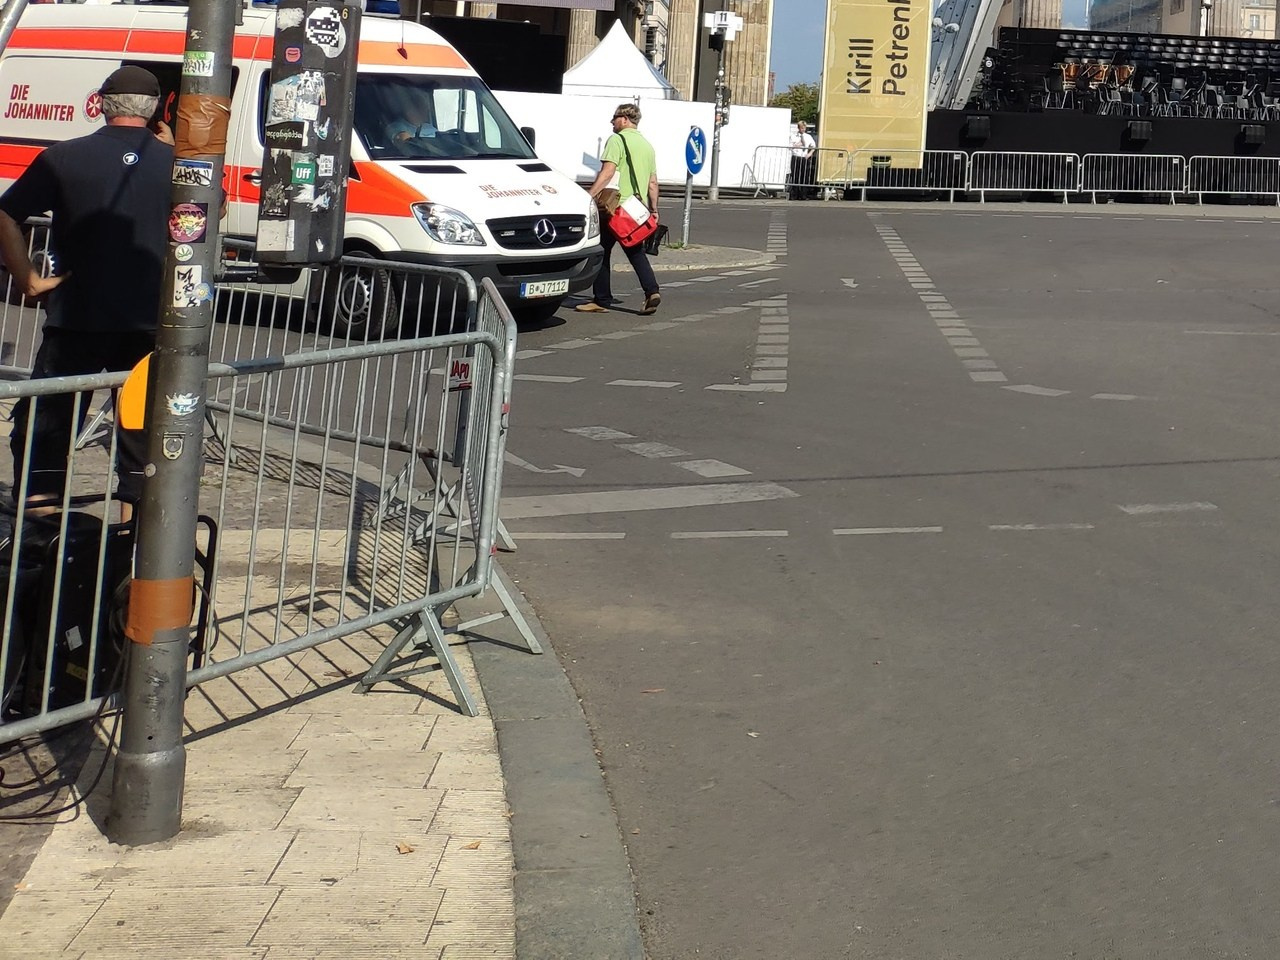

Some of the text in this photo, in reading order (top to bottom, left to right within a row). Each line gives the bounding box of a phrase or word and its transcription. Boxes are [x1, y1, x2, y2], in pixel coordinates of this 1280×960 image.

[847, 39, 874, 94] Kirill
[10, 84, 30, 100] DIE
[4, 102, 75, 121] JOHANNITER
[296, 168, 311, 178] Uff
[478, 184, 498, 192] DIE
[486, 189, 543, 199] JOHANNITER
